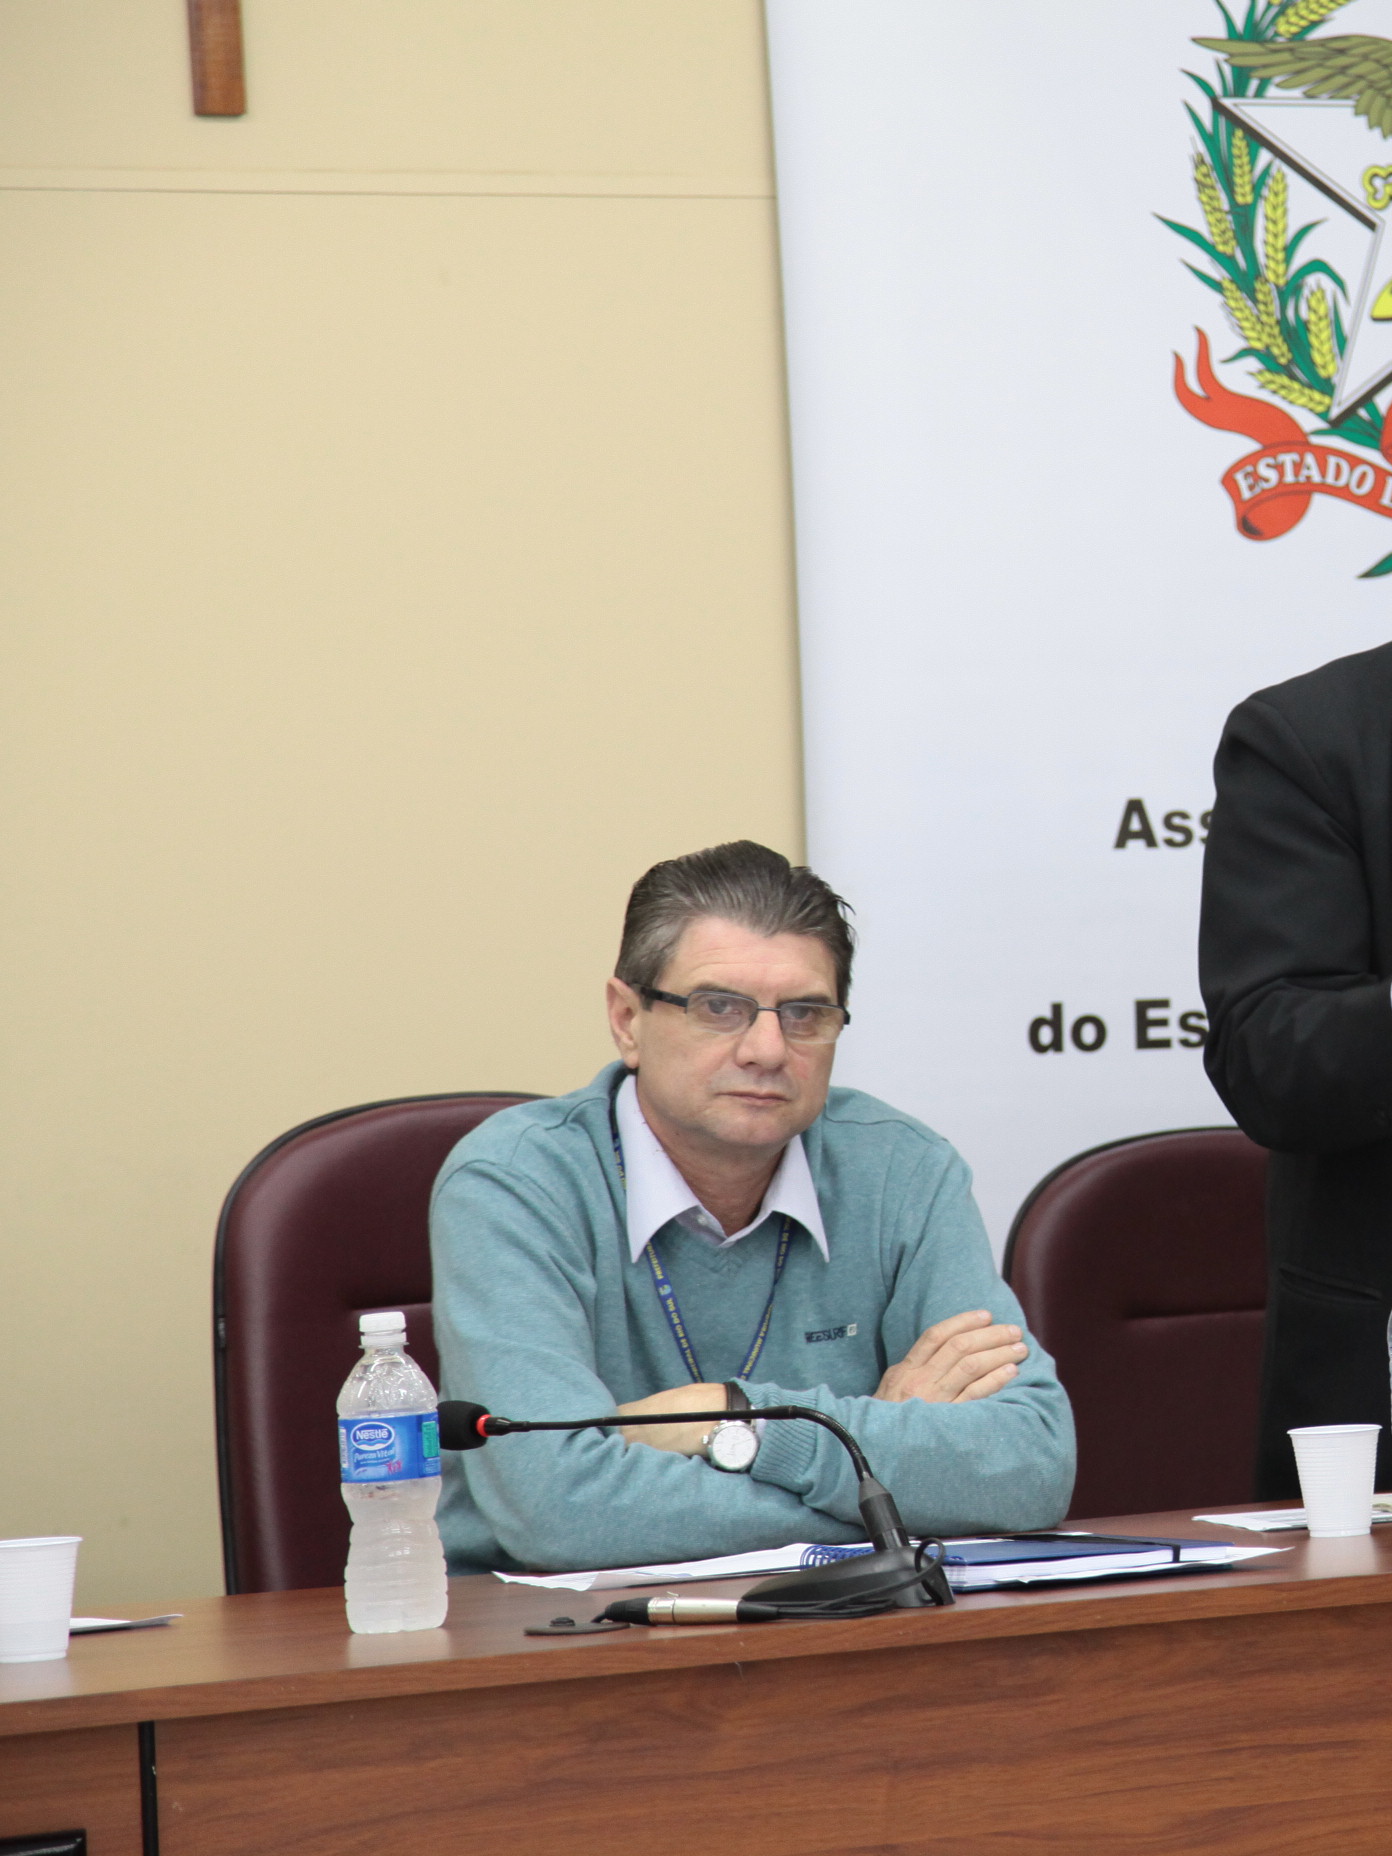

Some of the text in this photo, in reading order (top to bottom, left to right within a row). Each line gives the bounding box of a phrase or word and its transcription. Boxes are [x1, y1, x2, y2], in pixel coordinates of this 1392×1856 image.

[1233, 452, 1376, 501] ESTADO
[1028, 1002, 1108, 1054] do
[1135, 998, 1210, 1050] Es
